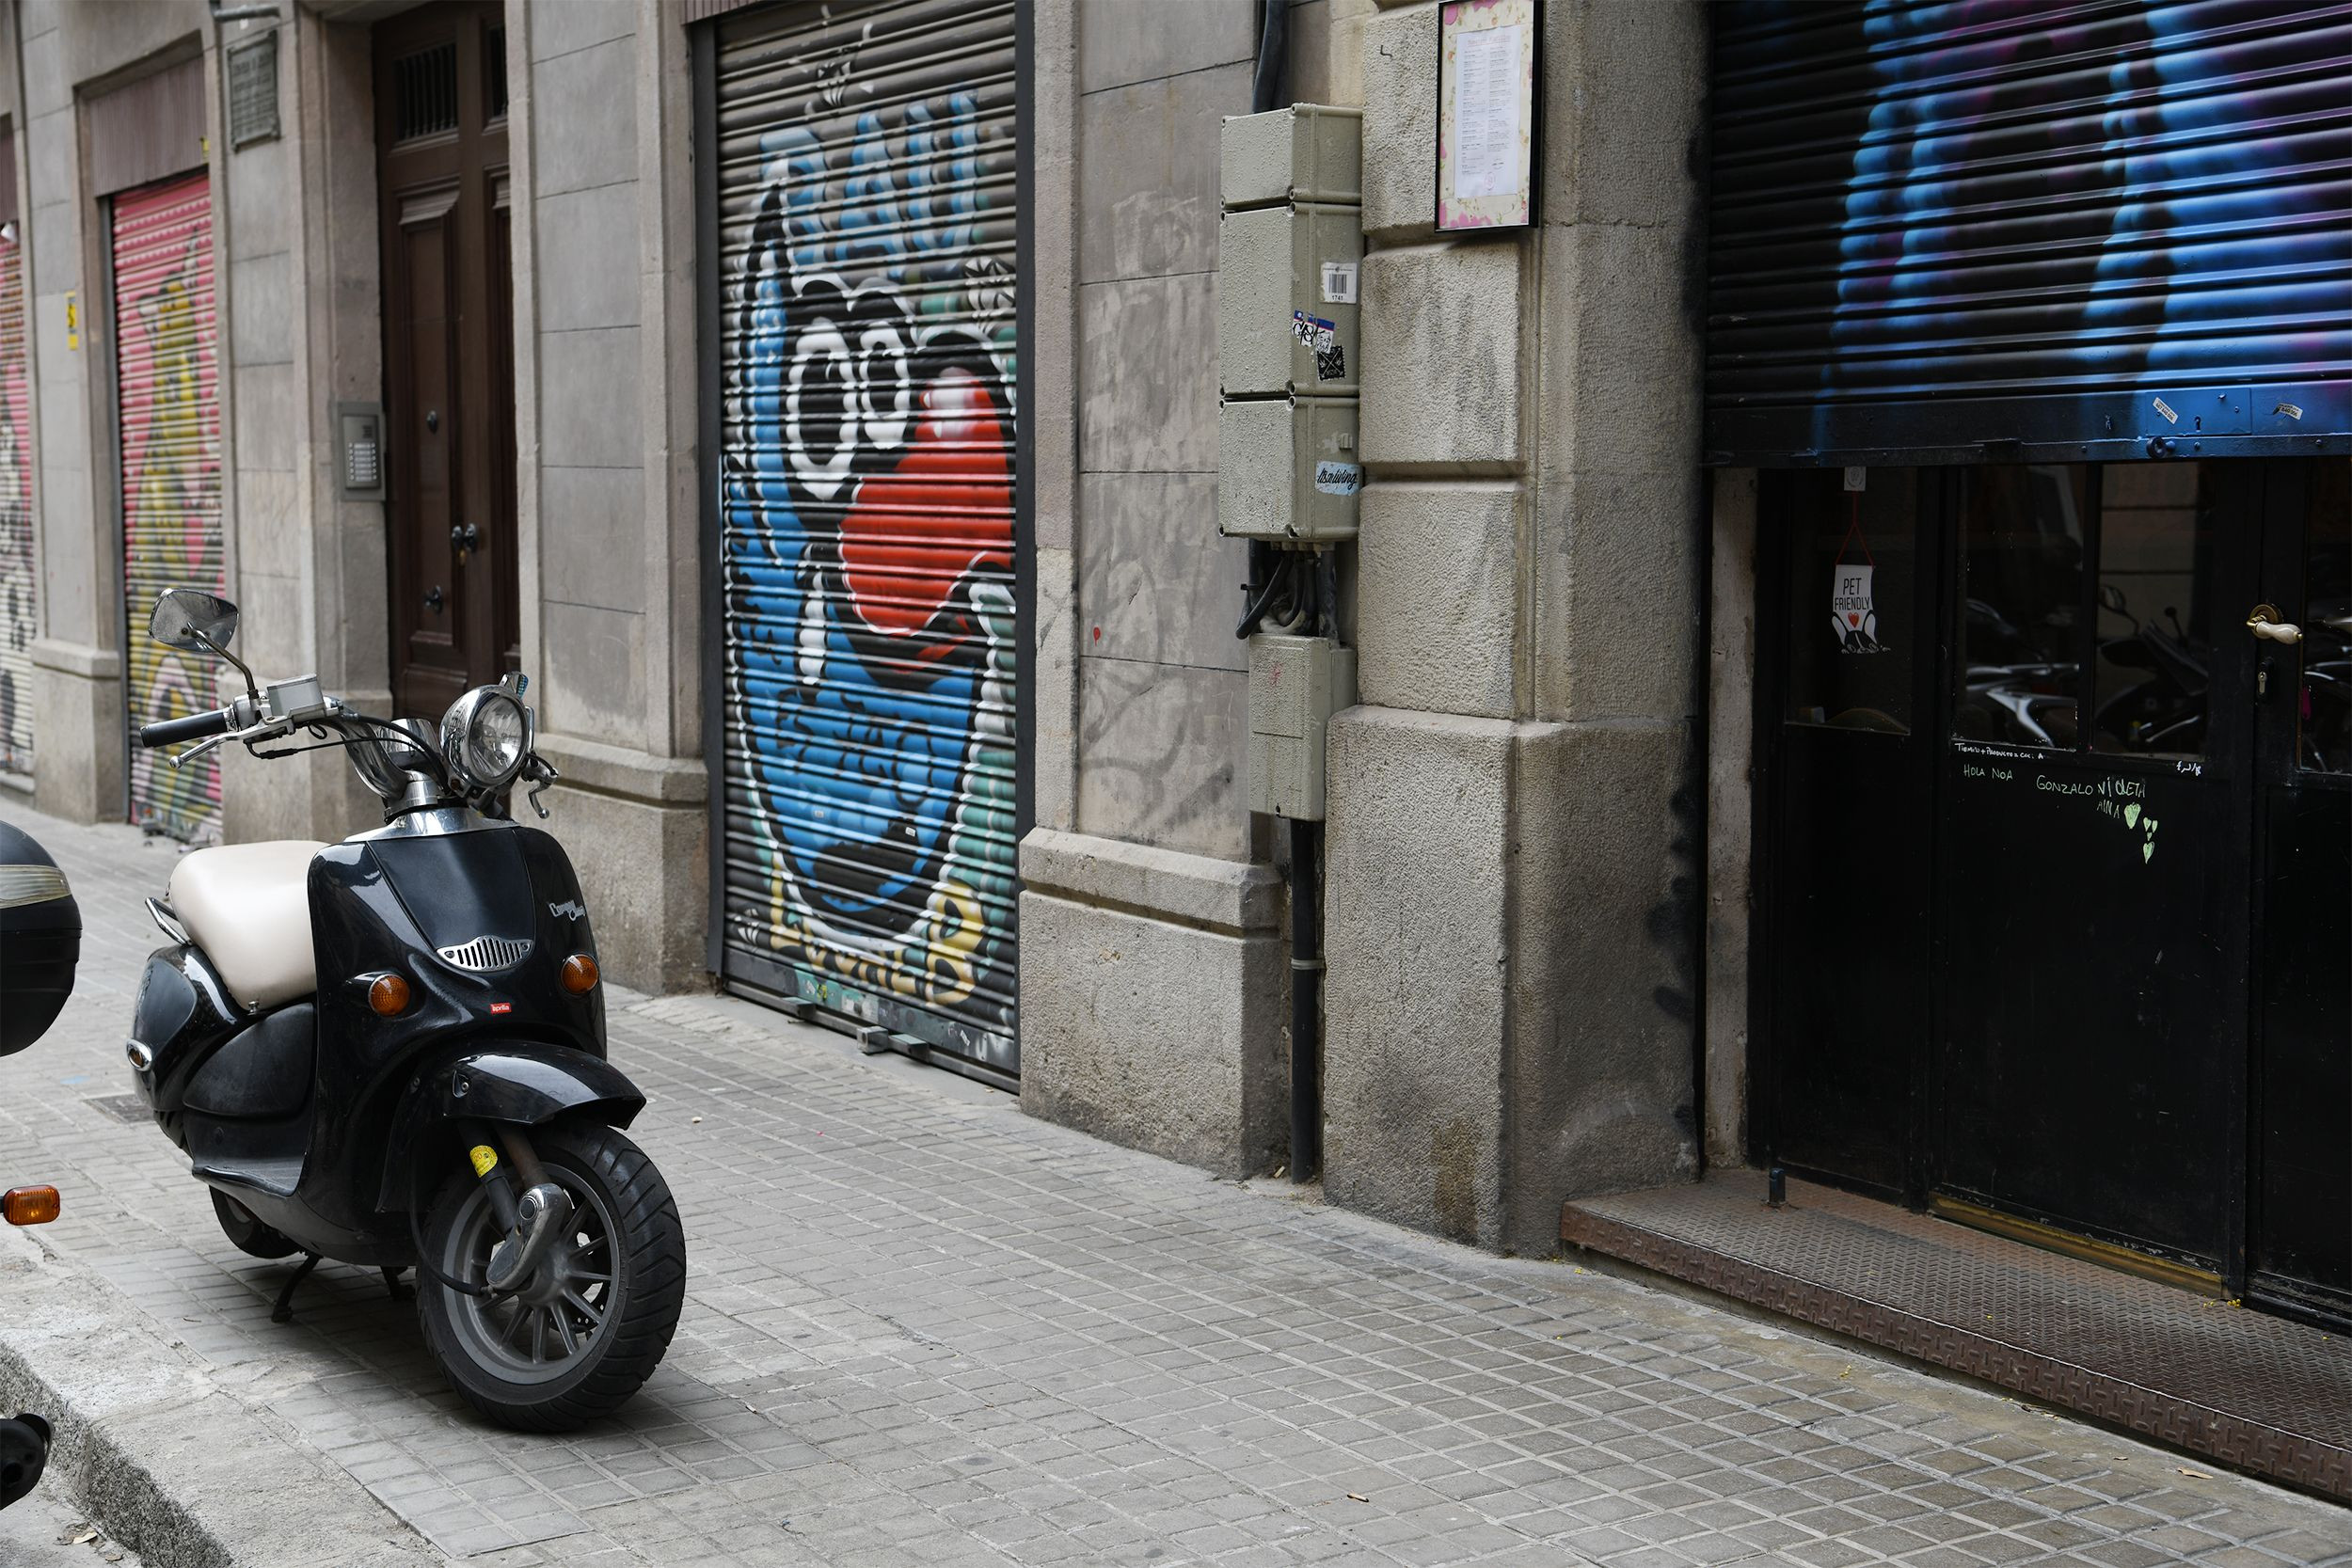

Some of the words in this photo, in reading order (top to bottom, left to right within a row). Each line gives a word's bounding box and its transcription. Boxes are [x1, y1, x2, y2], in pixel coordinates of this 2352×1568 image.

[1842, 578, 1862, 595] PET
[1834, 595, 1870, 611] FRIENDLY
[1963, 763, 1986, 778] HOLA
[2036, 774, 2094, 796] GONZALO
[2096, 776, 2146, 799] VIOLETA
[2096, 799, 2121, 819] AINA
